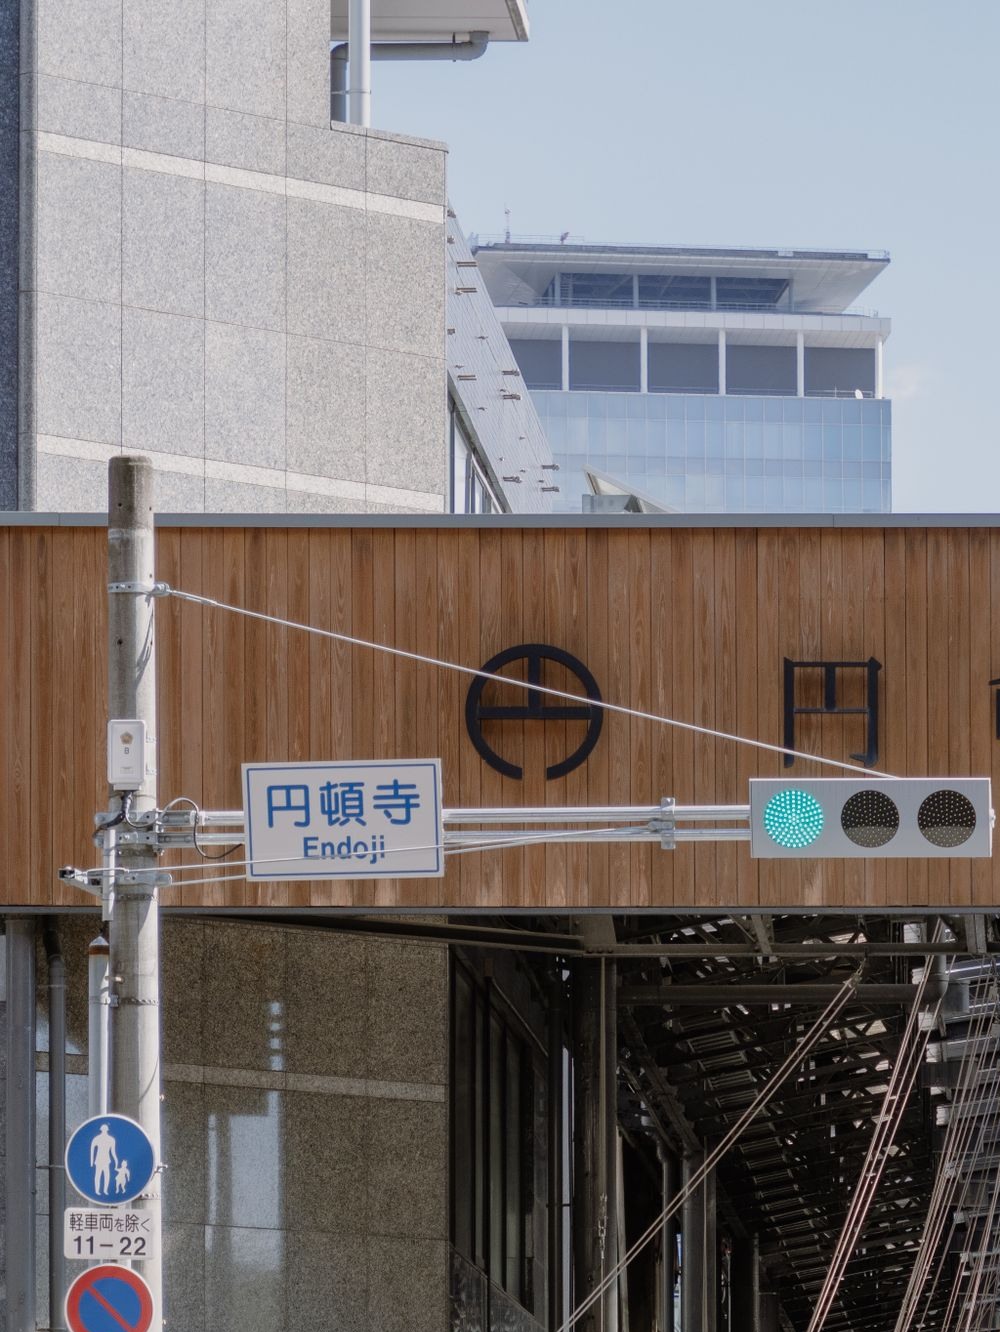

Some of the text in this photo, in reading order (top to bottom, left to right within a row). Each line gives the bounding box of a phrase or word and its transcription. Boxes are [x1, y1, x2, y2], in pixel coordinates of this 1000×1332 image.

[266, 778, 421, 829] 円頓寺
[303, 834, 386, 865] Endoji
[69, 1212, 151, 1233] 軽車両を除く
